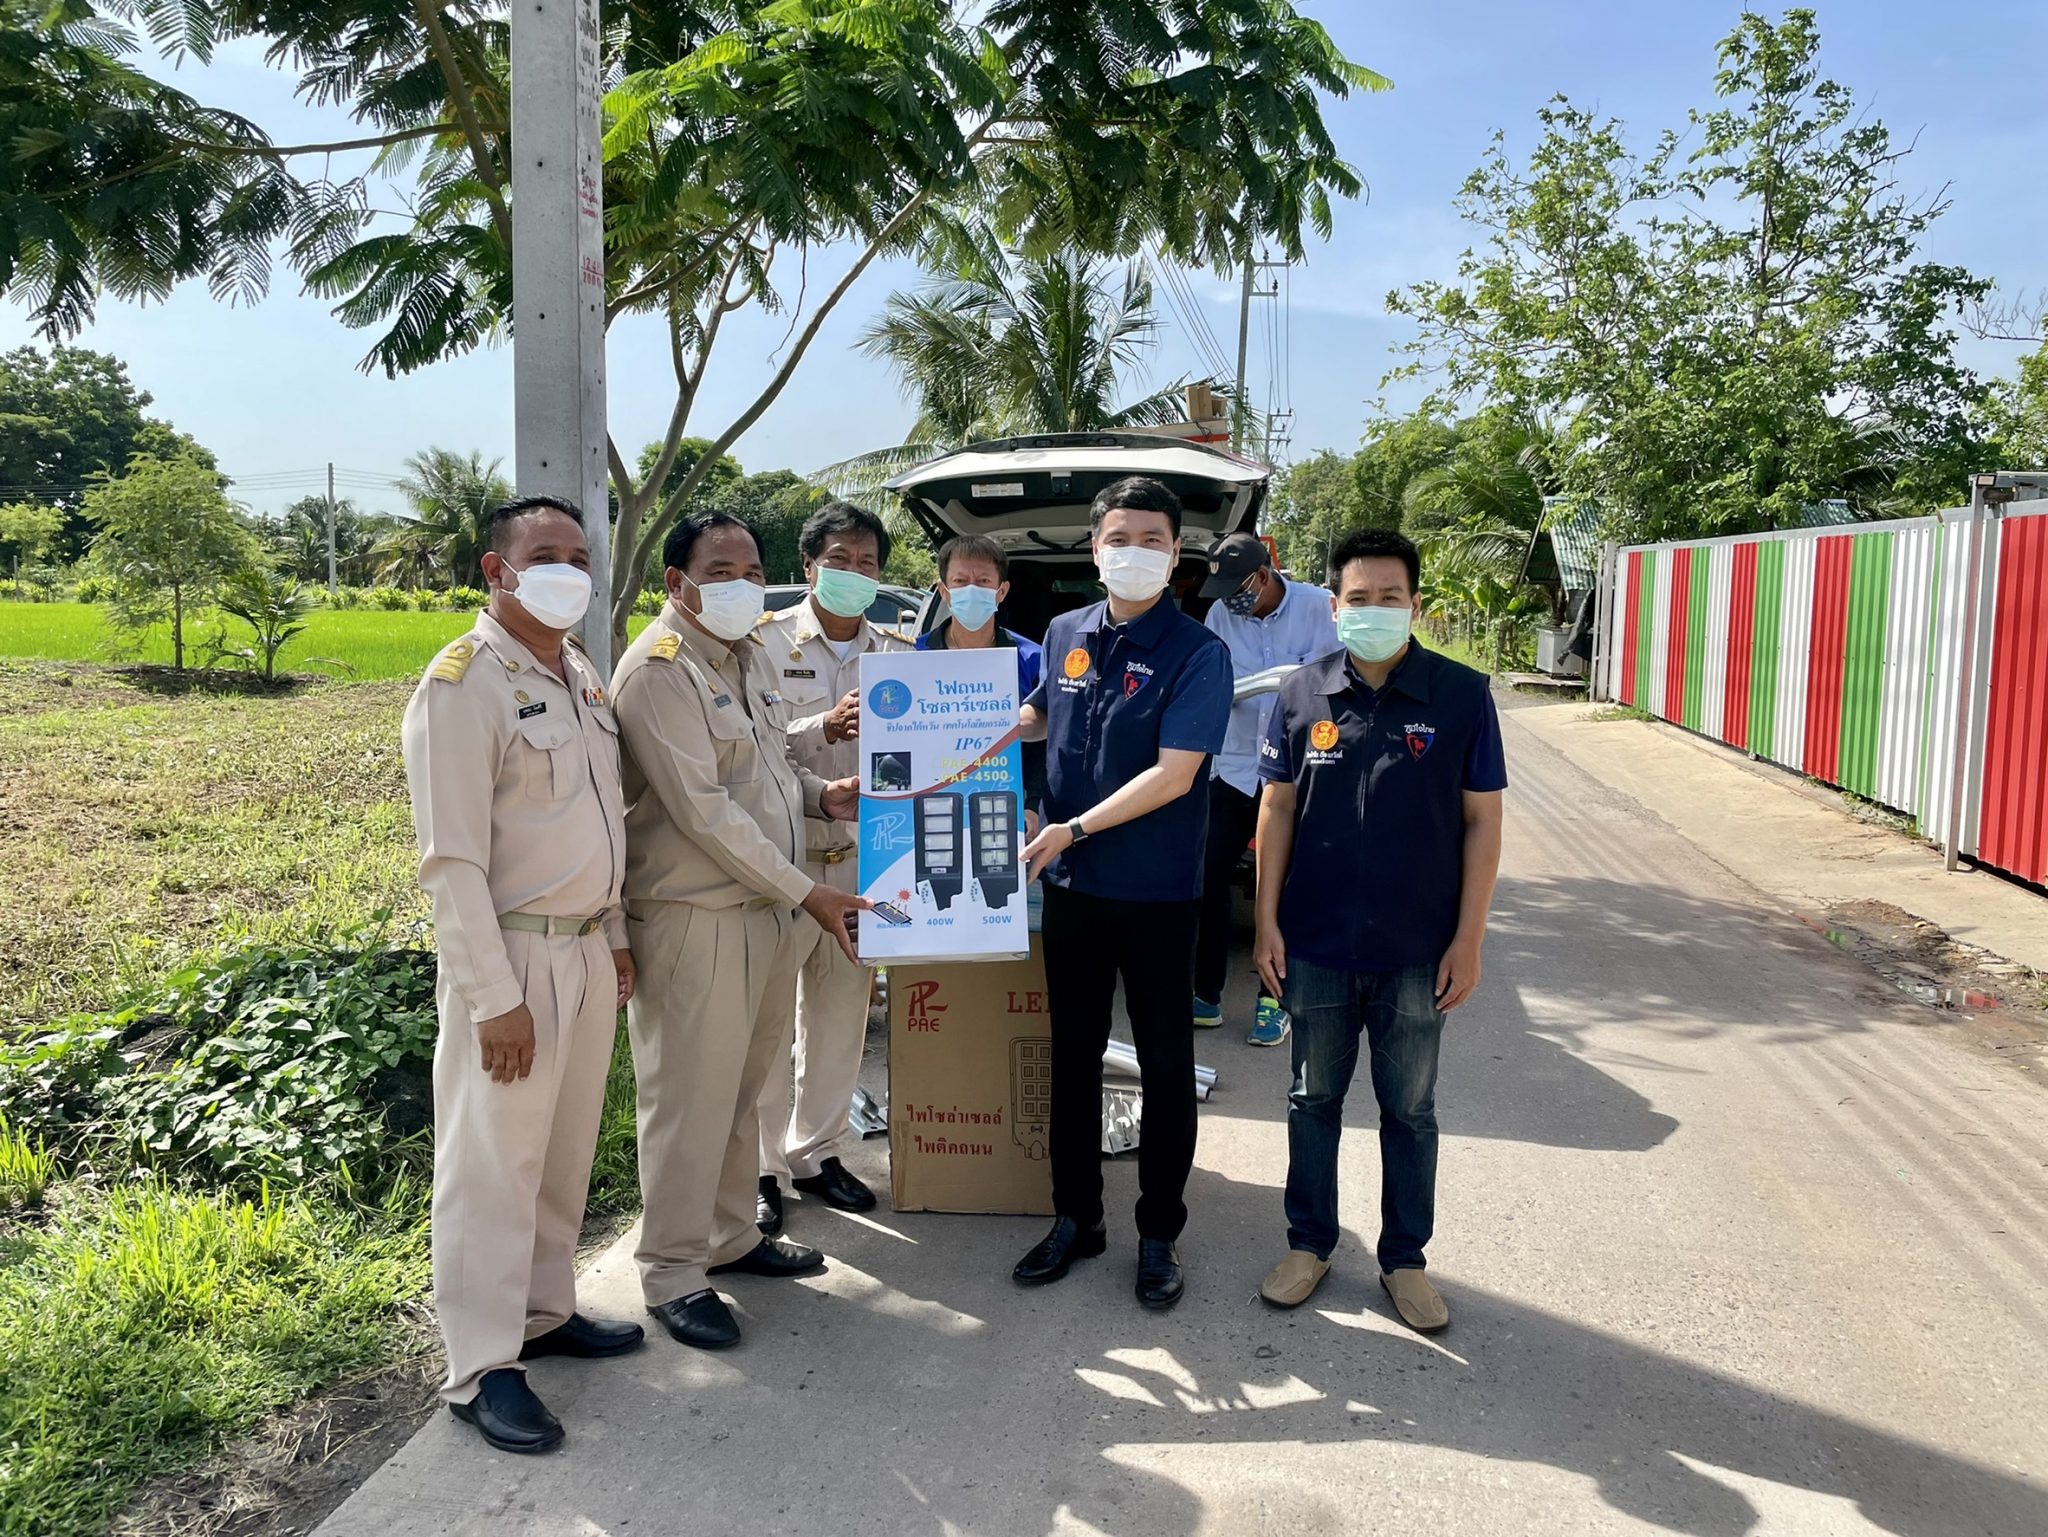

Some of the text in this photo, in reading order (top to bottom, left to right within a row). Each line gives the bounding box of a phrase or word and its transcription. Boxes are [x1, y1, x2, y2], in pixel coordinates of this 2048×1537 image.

[935, 680, 994, 695] ไฟถนน
[917, 693, 1012, 714] โซลาร์เซลล์
[955, 737, 993, 750] IP67
[926, 915, 1012, 926] 400W 500W
[1007, 991, 1050, 1013] LE
[908, 1018, 940, 1032] PAE
